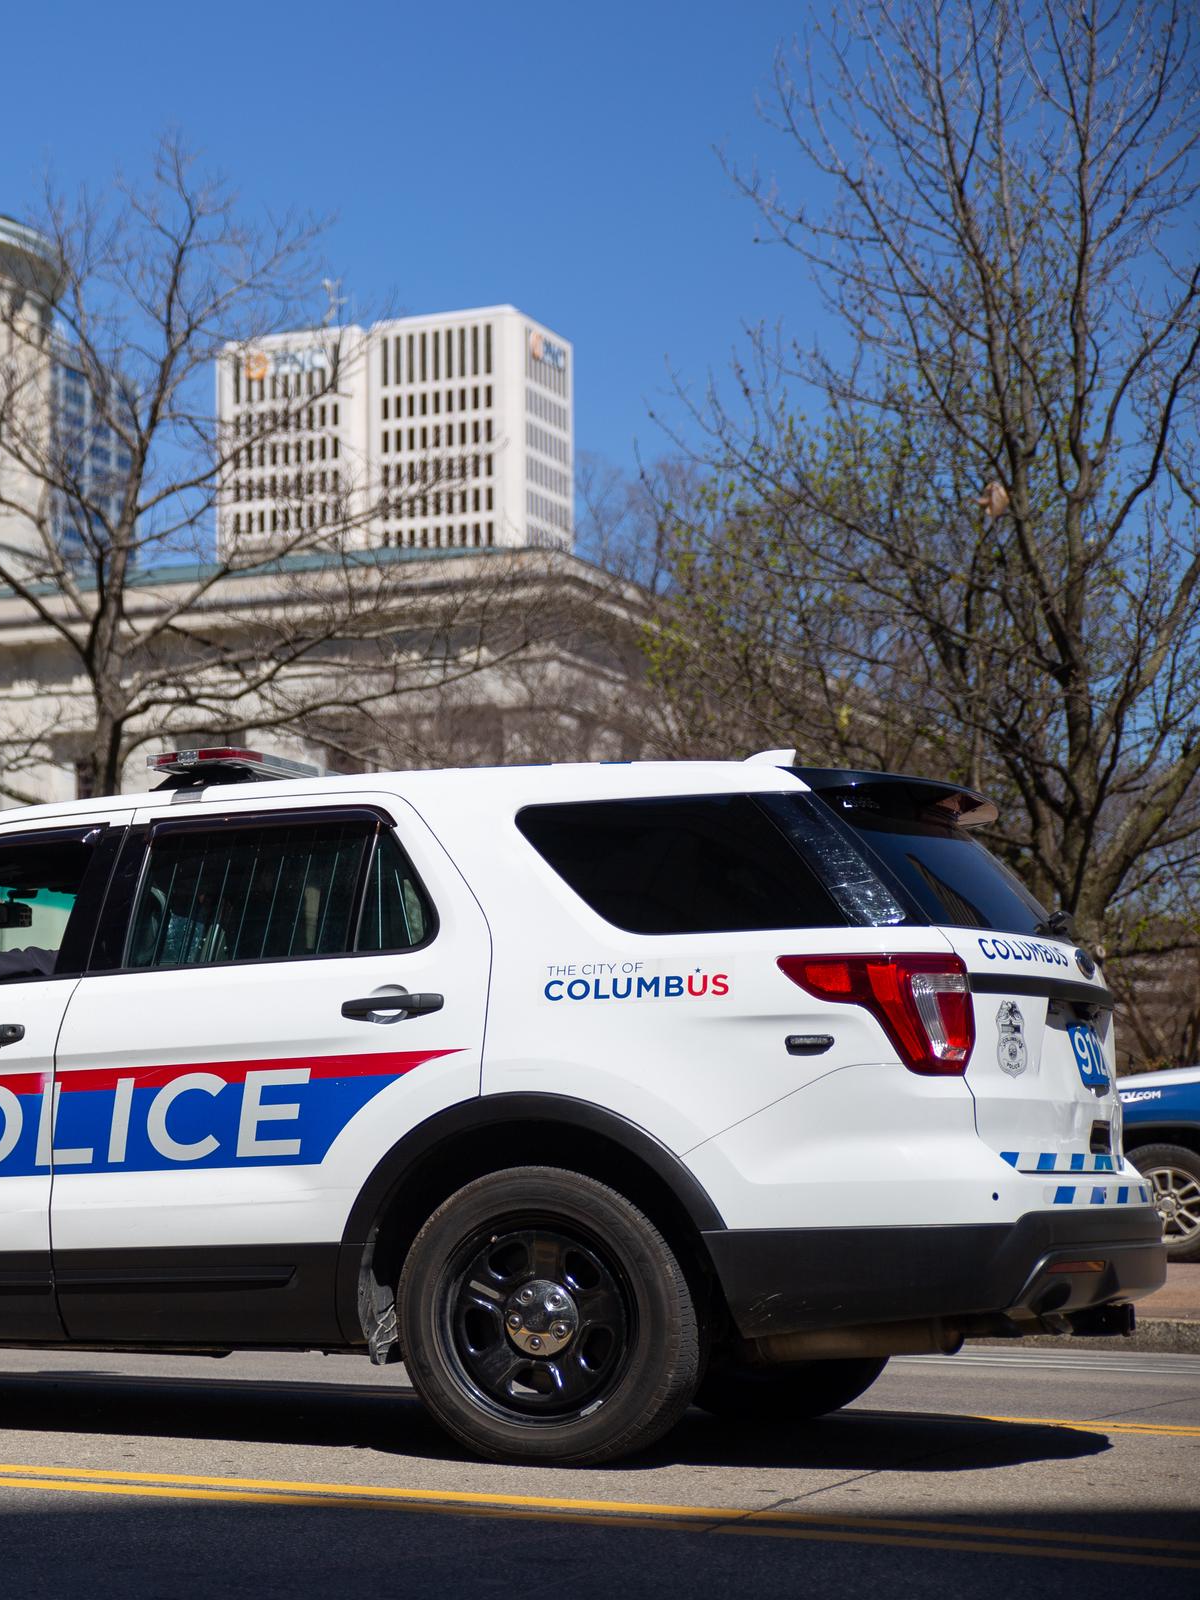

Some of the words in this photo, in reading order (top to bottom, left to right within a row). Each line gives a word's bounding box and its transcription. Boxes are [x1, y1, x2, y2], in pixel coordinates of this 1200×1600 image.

[977, 938, 1069, 967] COLUMBUS
[547, 965, 577, 977] THE
[581, 963, 617, 976] CITY
[621, 962, 644, 974] OF
[544, 974, 730, 1001] COLUMBUS
